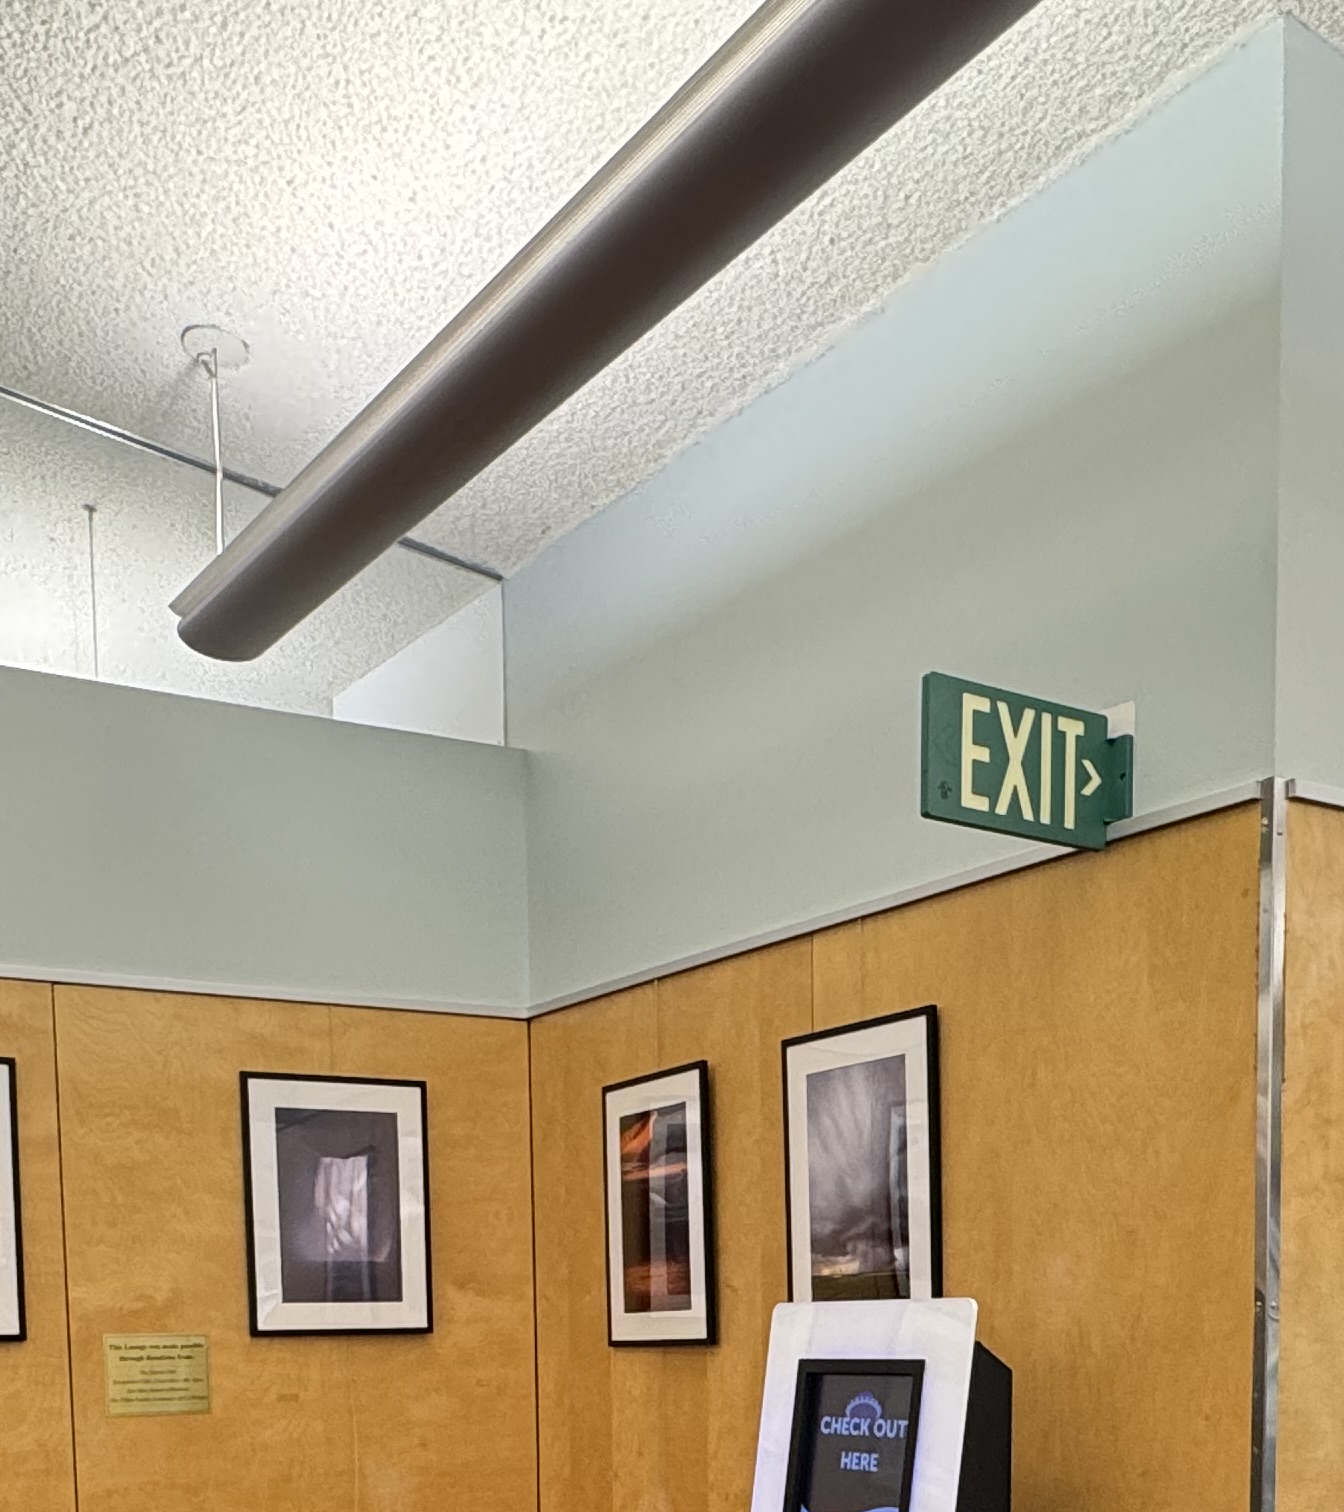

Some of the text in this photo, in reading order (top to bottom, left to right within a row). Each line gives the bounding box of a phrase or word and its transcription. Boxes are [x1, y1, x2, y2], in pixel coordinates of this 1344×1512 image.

[960, 691, 1086, 831] EXIT
[820, 1415, 909, 1439] CHECK OUT
[840, 1450, 879, 1473] HERE
